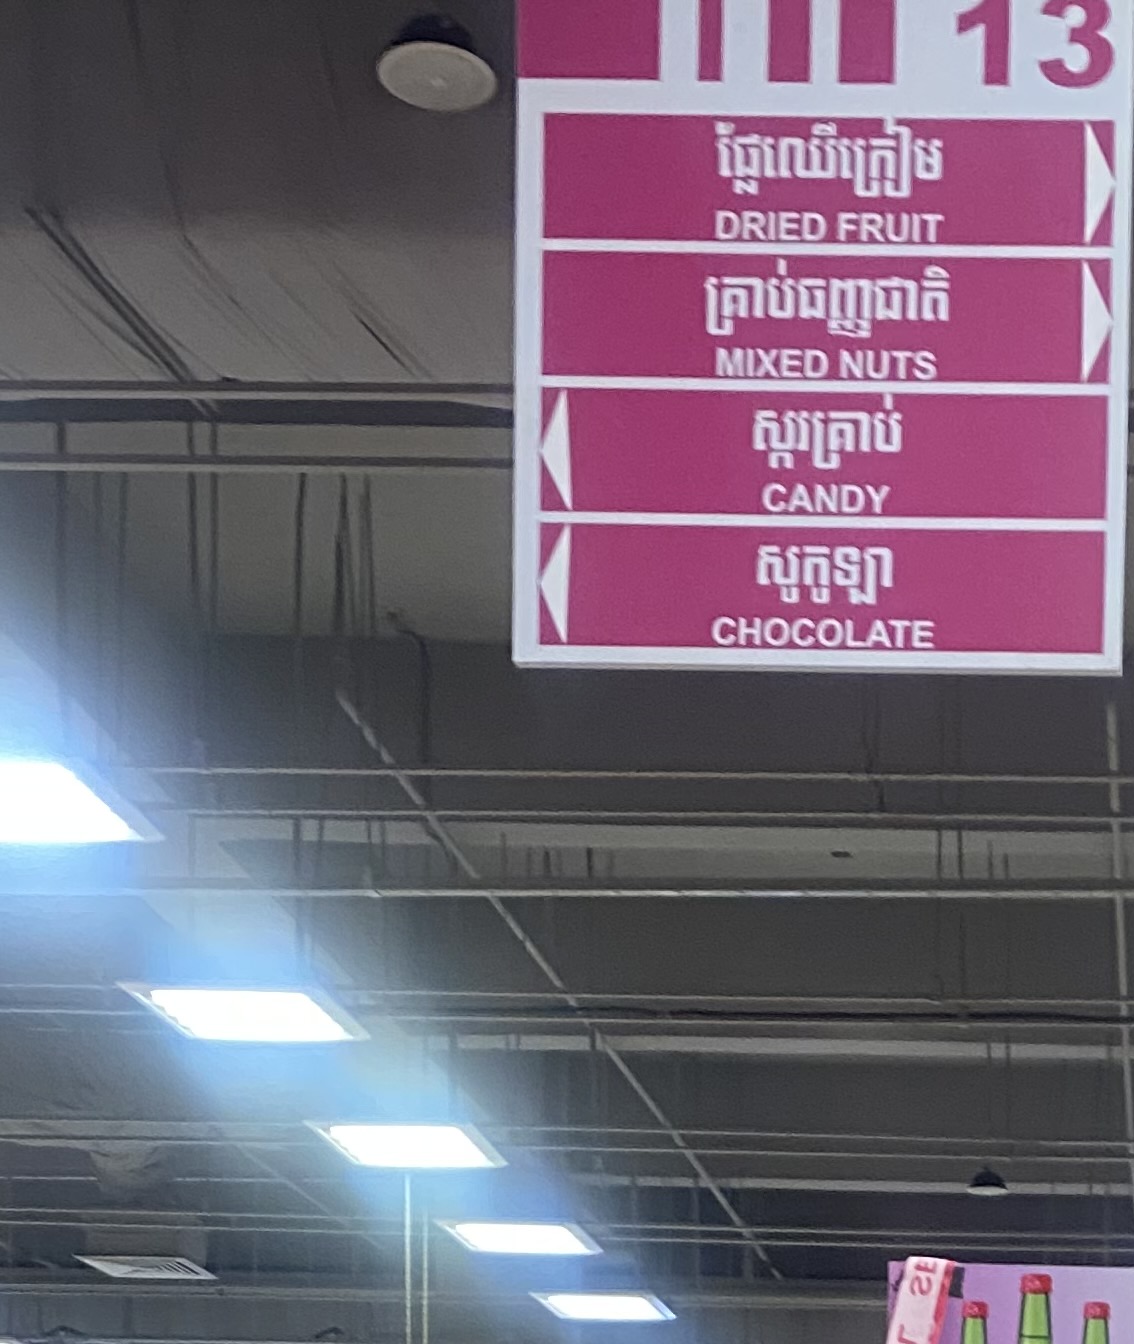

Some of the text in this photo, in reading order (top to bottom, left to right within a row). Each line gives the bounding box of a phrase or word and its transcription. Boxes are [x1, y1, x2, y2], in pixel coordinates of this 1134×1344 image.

[956, 0, 1117, 88] 13
[715, 211, 945, 242] DRIED FRUIT
[715, 347, 938, 379] MIXED NUTS
[762, 484, 891, 514] CANDY
[712, 616, 935, 648] CHOCOLATE
